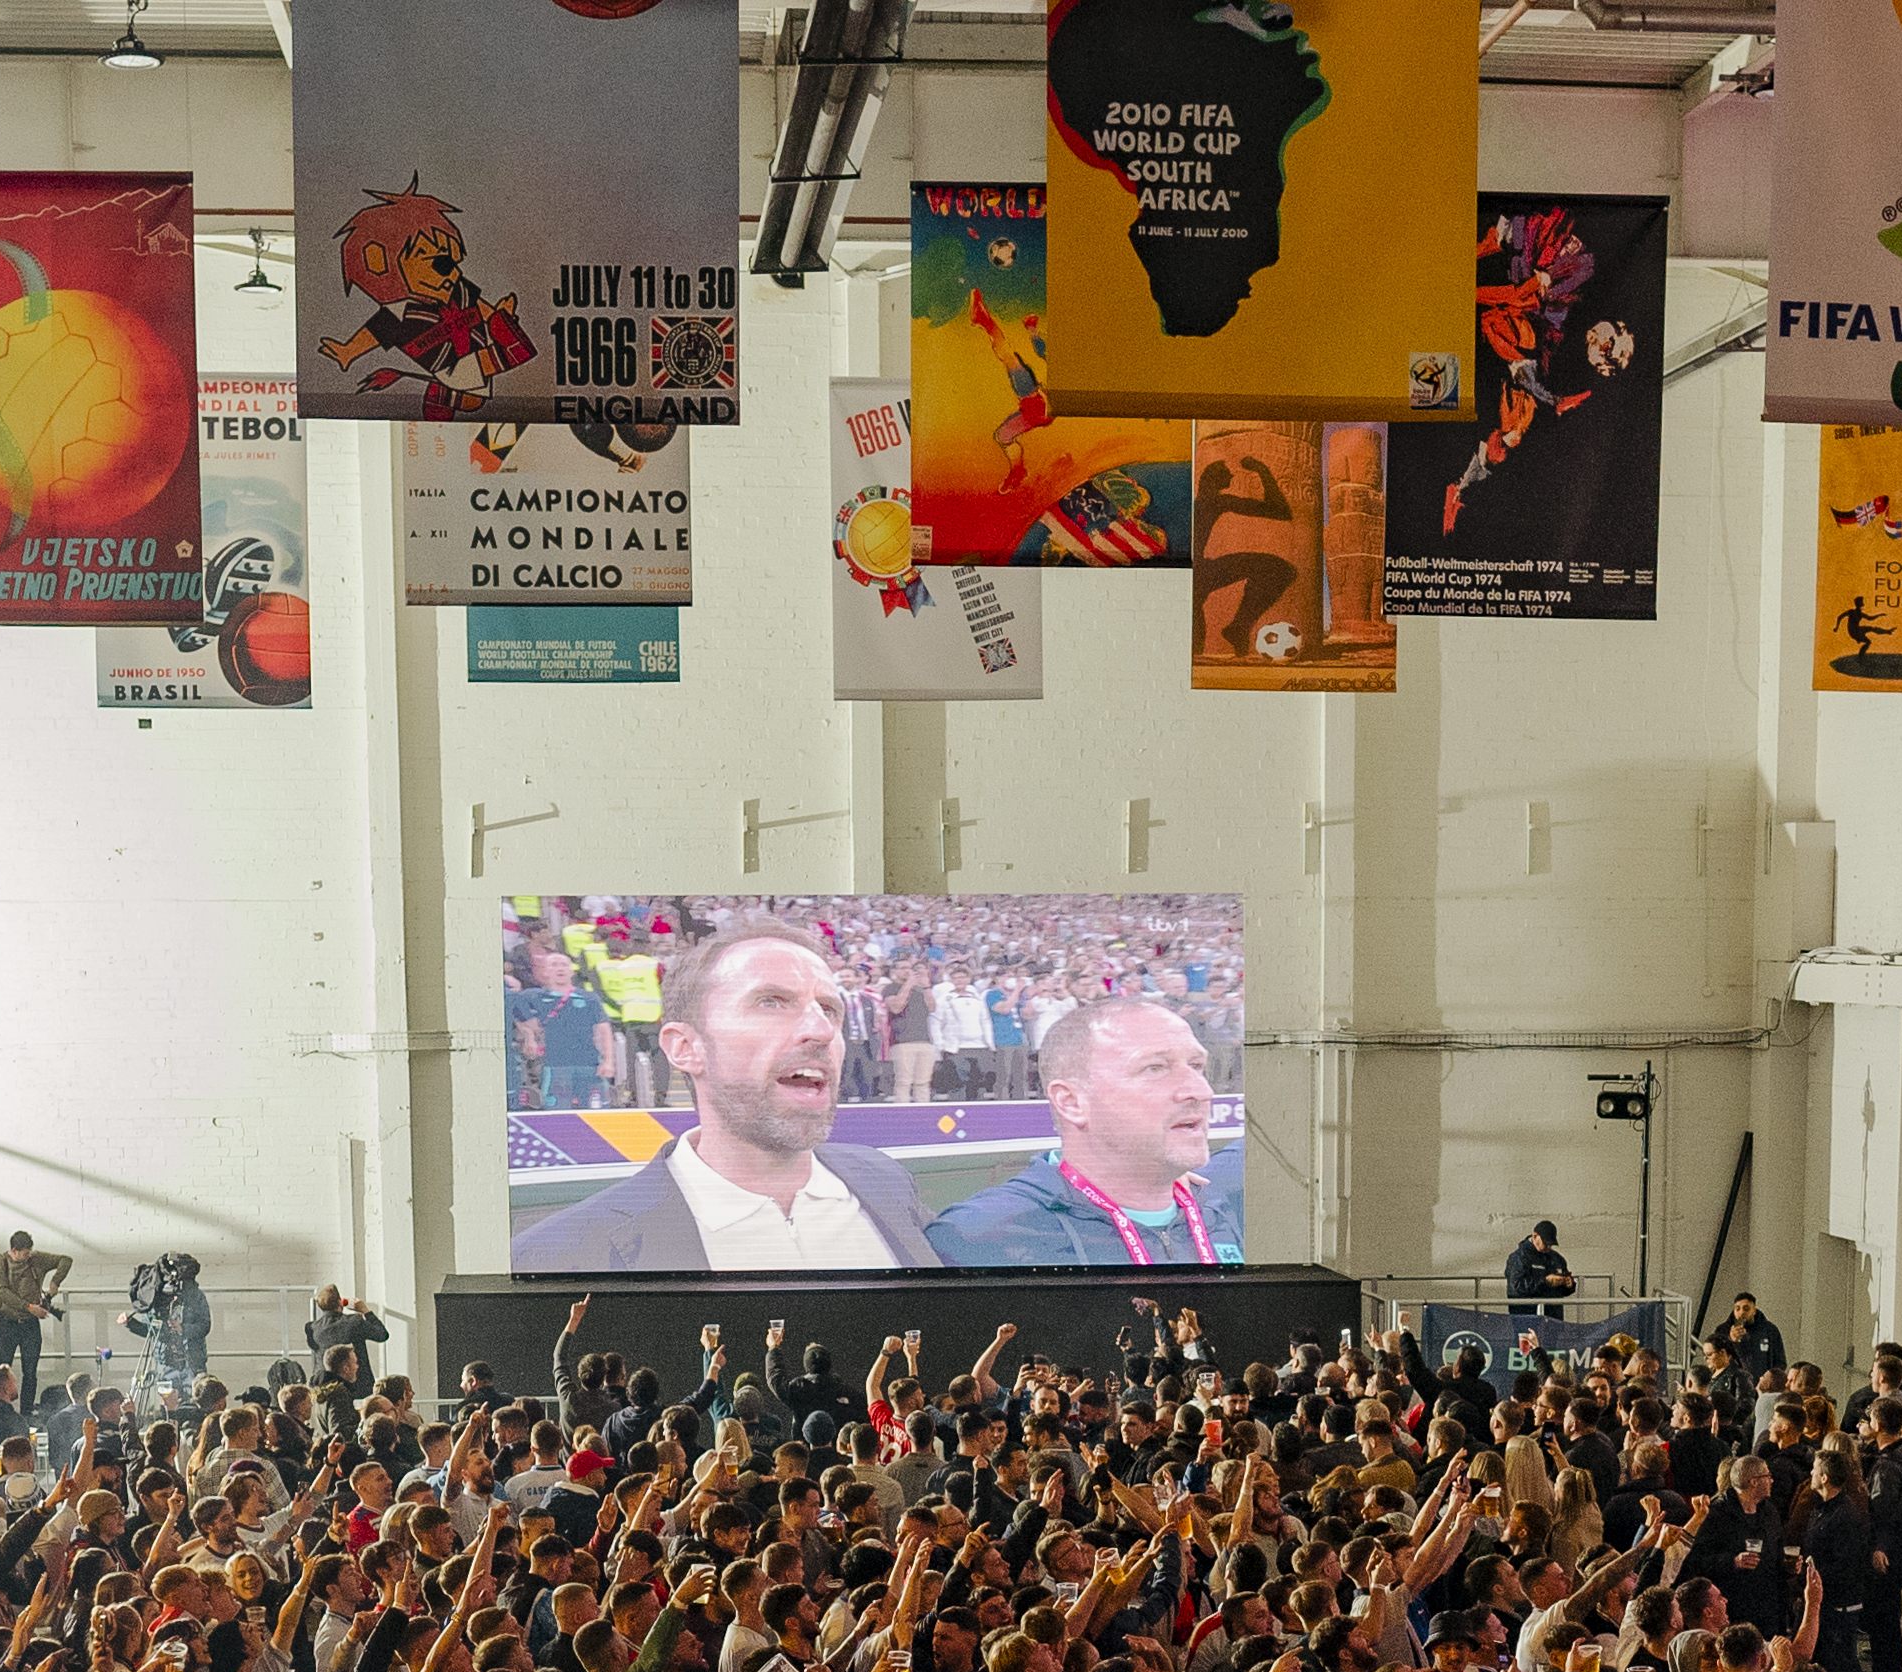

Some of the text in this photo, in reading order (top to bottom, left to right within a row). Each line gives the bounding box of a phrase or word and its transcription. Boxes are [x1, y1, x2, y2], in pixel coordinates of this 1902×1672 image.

[1105, 102, 1235, 127] 2010 FIFA
[1093, 129, 1241, 155] WORLD CUP
[1126, 159, 1212, 183] SOUTH
[926, 187, 1047, 218] WORLD
[1148, 226, 1173, 236] JUNE
[1194, 227, 1218, 237] JULY
[1221, 228, 1249, 238] 2010
[552, 264, 736, 310] JULY 11 to 30
[1778, 300, 1881, 342] FIFA
[550, 316, 637, 387] 1966
[553, 395, 736, 424] ENGLAND
[202, 416, 302, 441] TEBOL
[845, 404, 902, 458] 1966
[409, 488, 446, 498] ITALIA
[470, 488, 688, 514] CAMPIONATO
[469, 526, 689, 551] MONDIALE
[472, 564, 623, 589] DI CALCIO
[647, 567, 690, 576] MAGGIO
[1385, 556, 1564, 573] Fußball-Weltmeisterschaft 1974
[649, 582, 690, 590] GIUGNO
[1386, 572, 1502, 587] FIFA World Cup 1974
[1384, 586, 1572, 603] Coupe du Monde de la FIFA 1974
[1384, 602, 1415, 615] Copa
[1417, 602, 1466, 615] Mundial
[1499, 604, 1523, 616] FIFA
[1525, 605, 1553, 616] 1974
[638, 641, 677, 656] CHILE
[109, 668, 206, 678] JUNHO DE 1950
[639, 656, 677, 672] 1962
[114, 684, 202, 701] BRASIL
